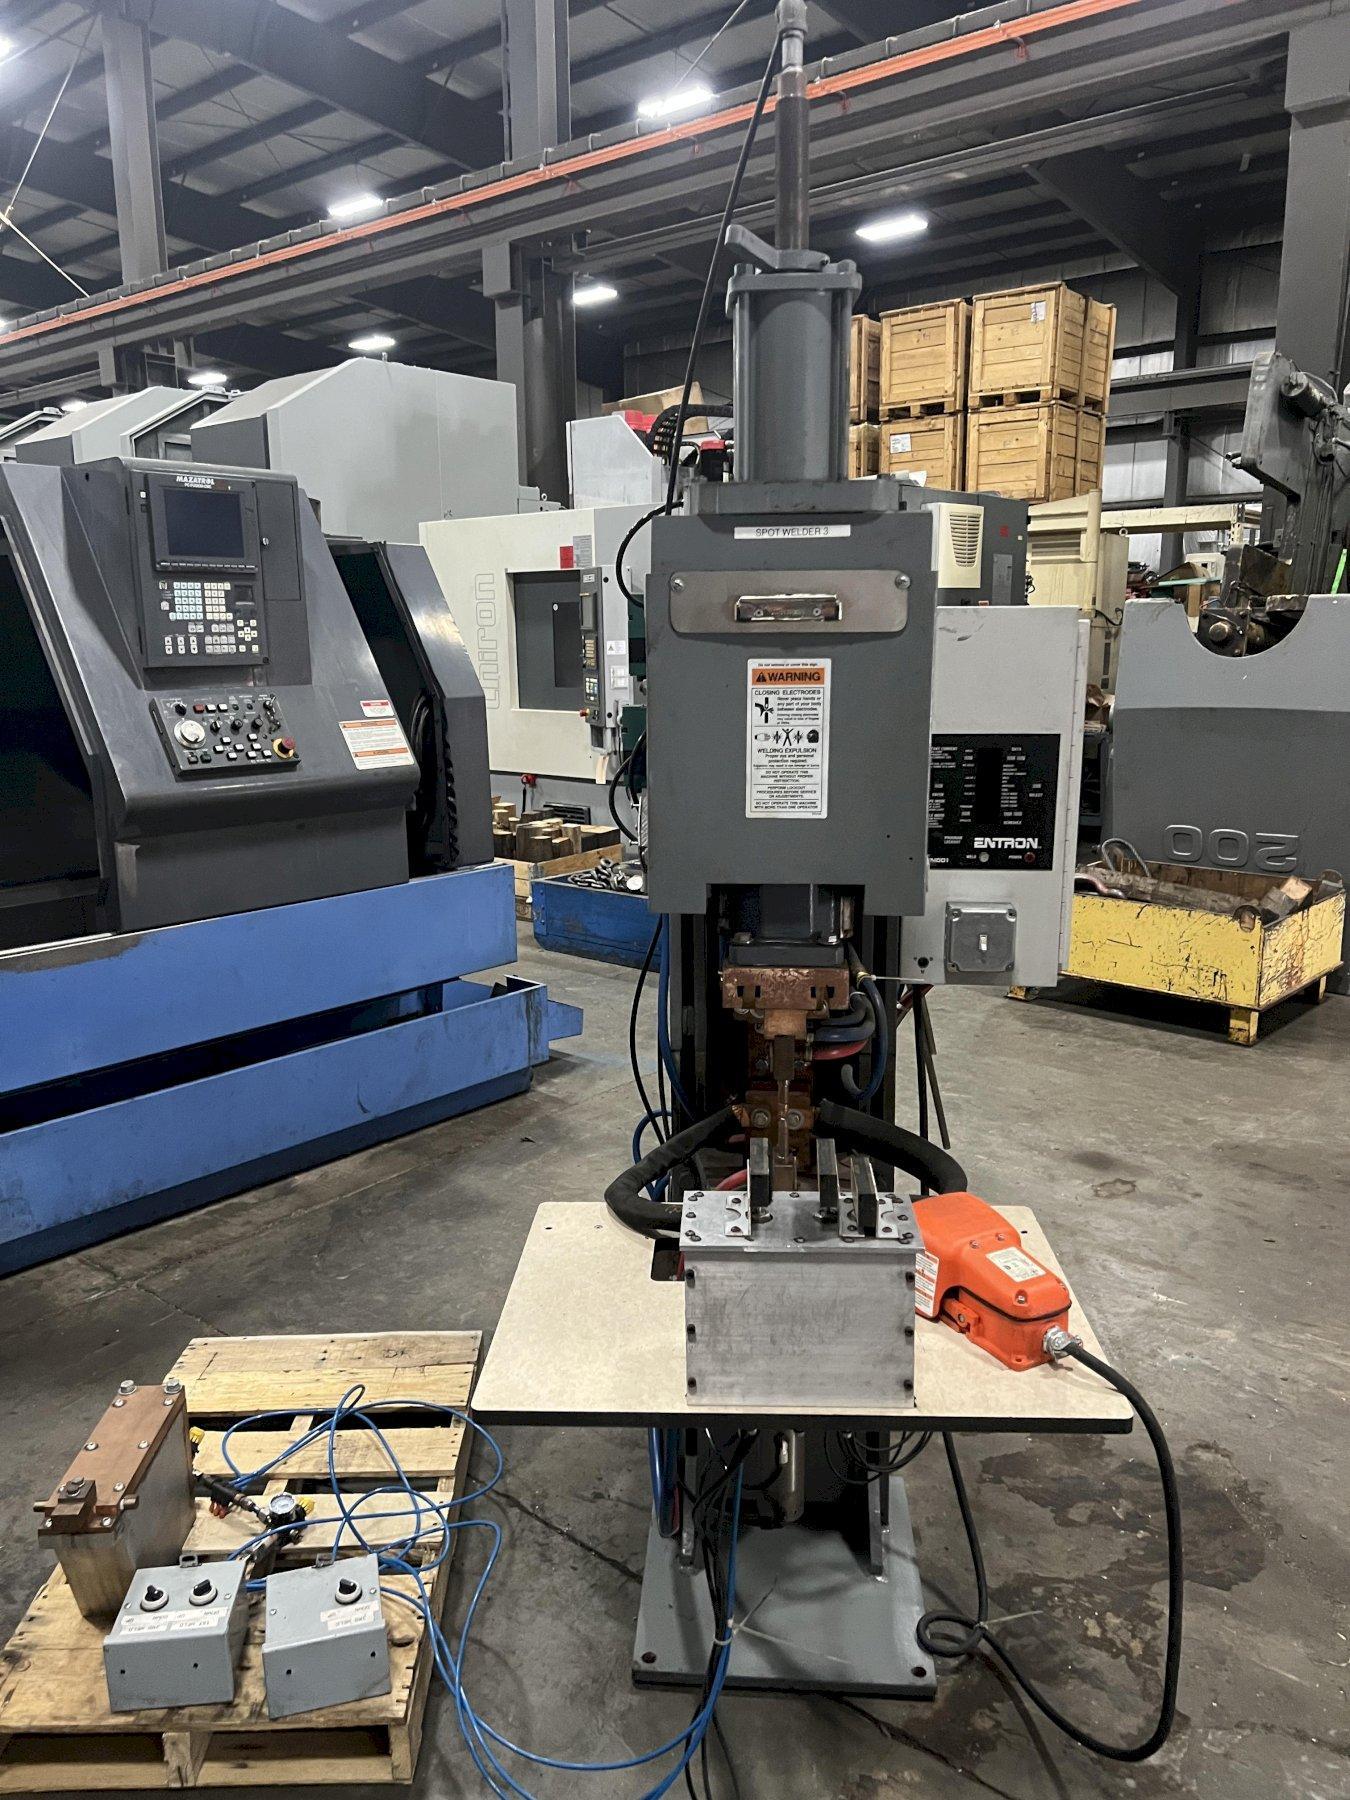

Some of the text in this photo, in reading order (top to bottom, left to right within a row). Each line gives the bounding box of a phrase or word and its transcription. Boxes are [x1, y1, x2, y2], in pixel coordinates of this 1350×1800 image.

[176, 476, 214, 485] MAZATROL
[756, 527, 829, 537] SPOT WELDER 3
[768, 672, 820, 681] WARNING
[974, 837, 1039, 849] ENTRON
